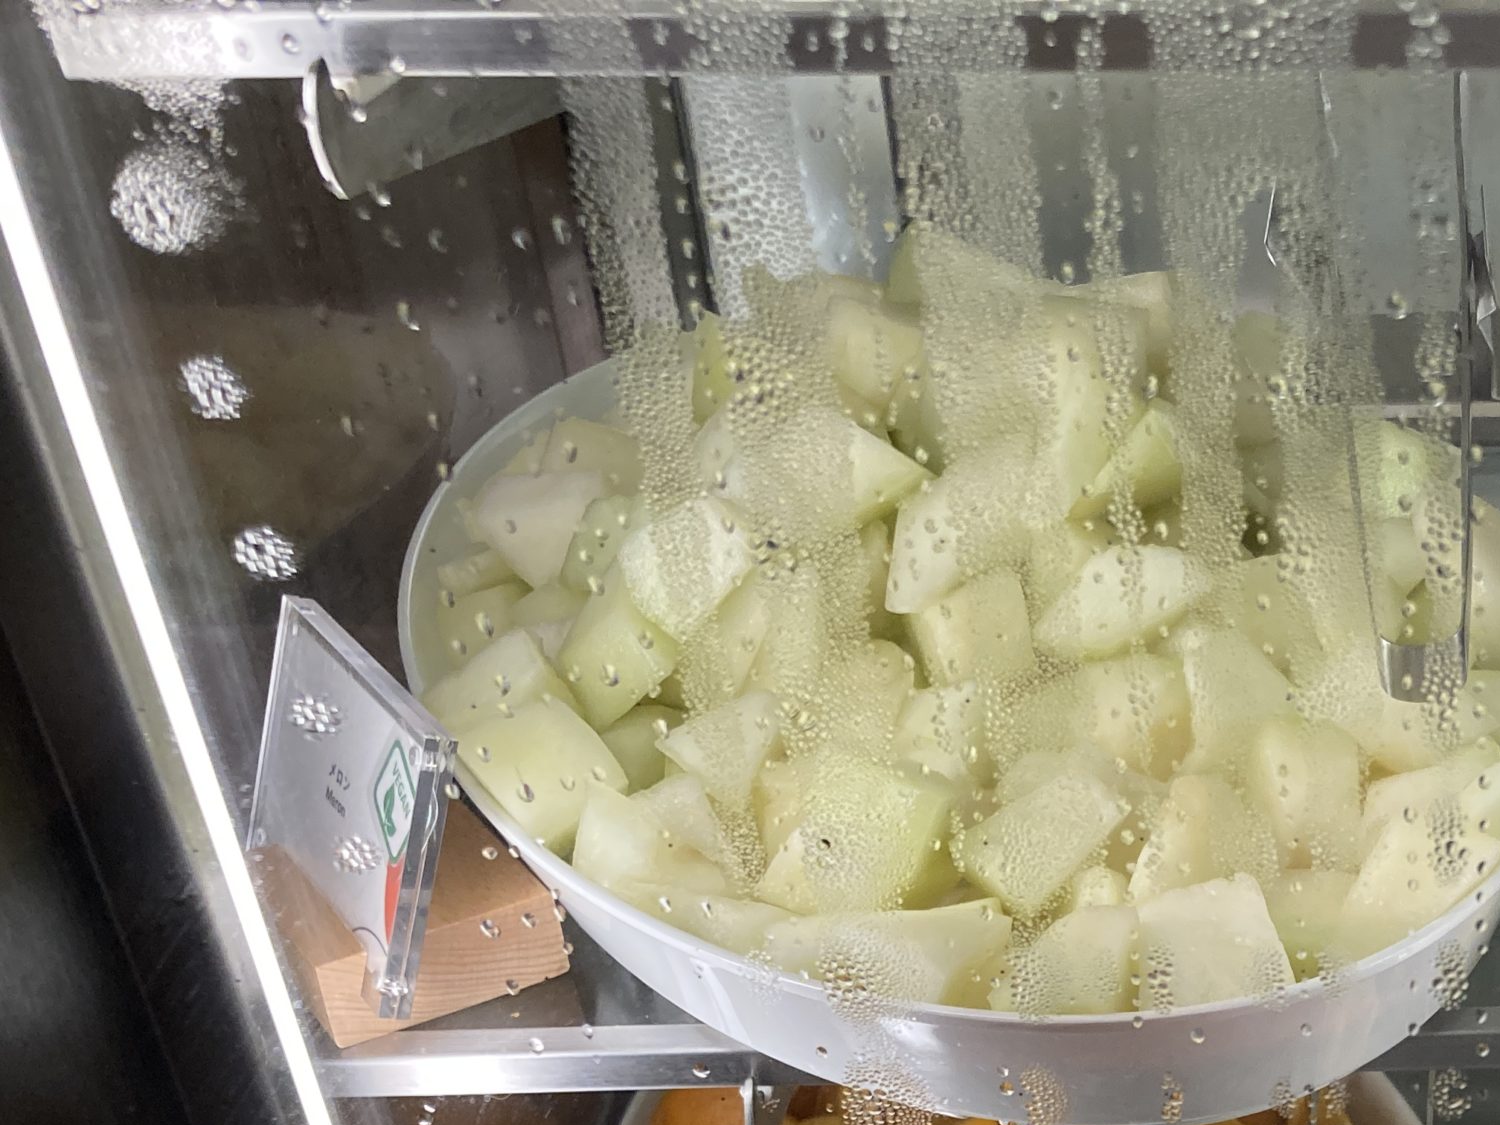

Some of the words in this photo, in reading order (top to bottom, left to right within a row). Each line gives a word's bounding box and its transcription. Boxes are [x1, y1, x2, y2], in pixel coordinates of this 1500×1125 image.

[329, 764, 351, 790] メロン
[393, 762, 411, 819] VEGAN
